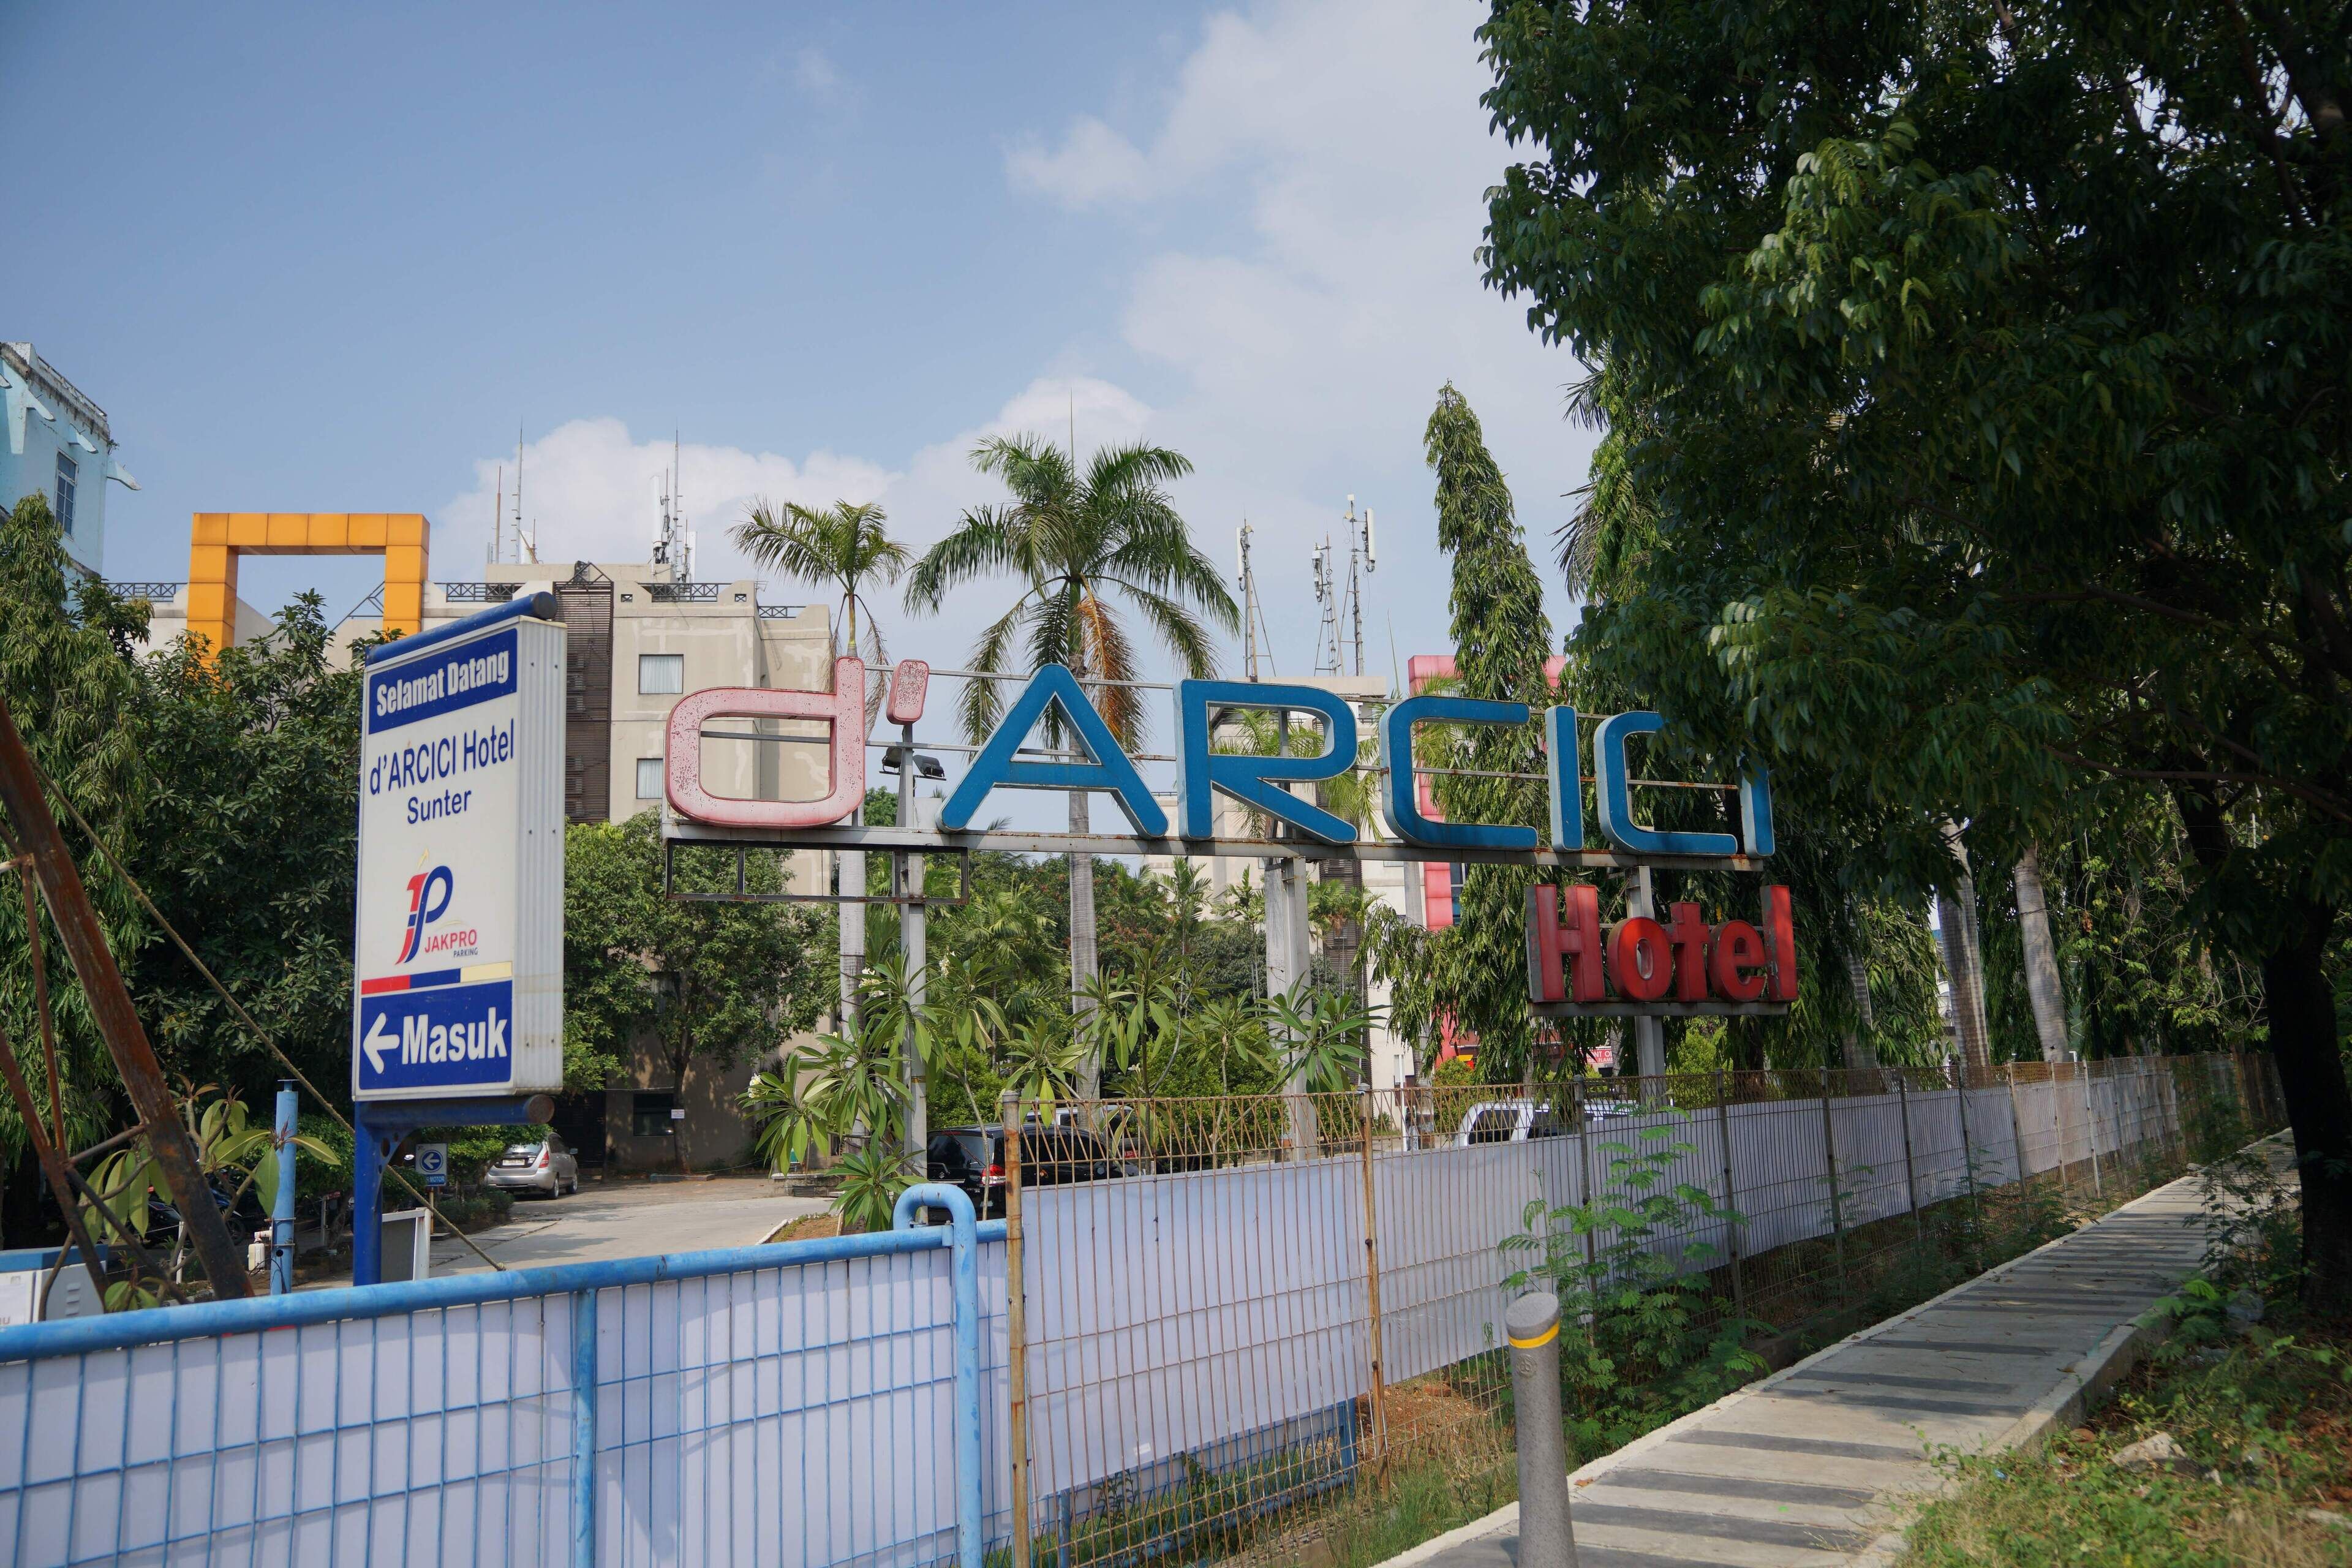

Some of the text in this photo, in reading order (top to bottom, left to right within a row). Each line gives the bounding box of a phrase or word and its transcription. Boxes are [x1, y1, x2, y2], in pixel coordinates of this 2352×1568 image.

[376, 650, 510, 717] Selamat Datang
[369, 718, 514, 796] d'ARCICI Hotel
[407, 789, 472, 825] Sunter
[424, 929, 477, 954] JAKPRO
[453, 947, 478, 957] PARKING
[1525, 883, 1799, 1003] Hotel
[401, 1007, 508, 1065] Masuk
